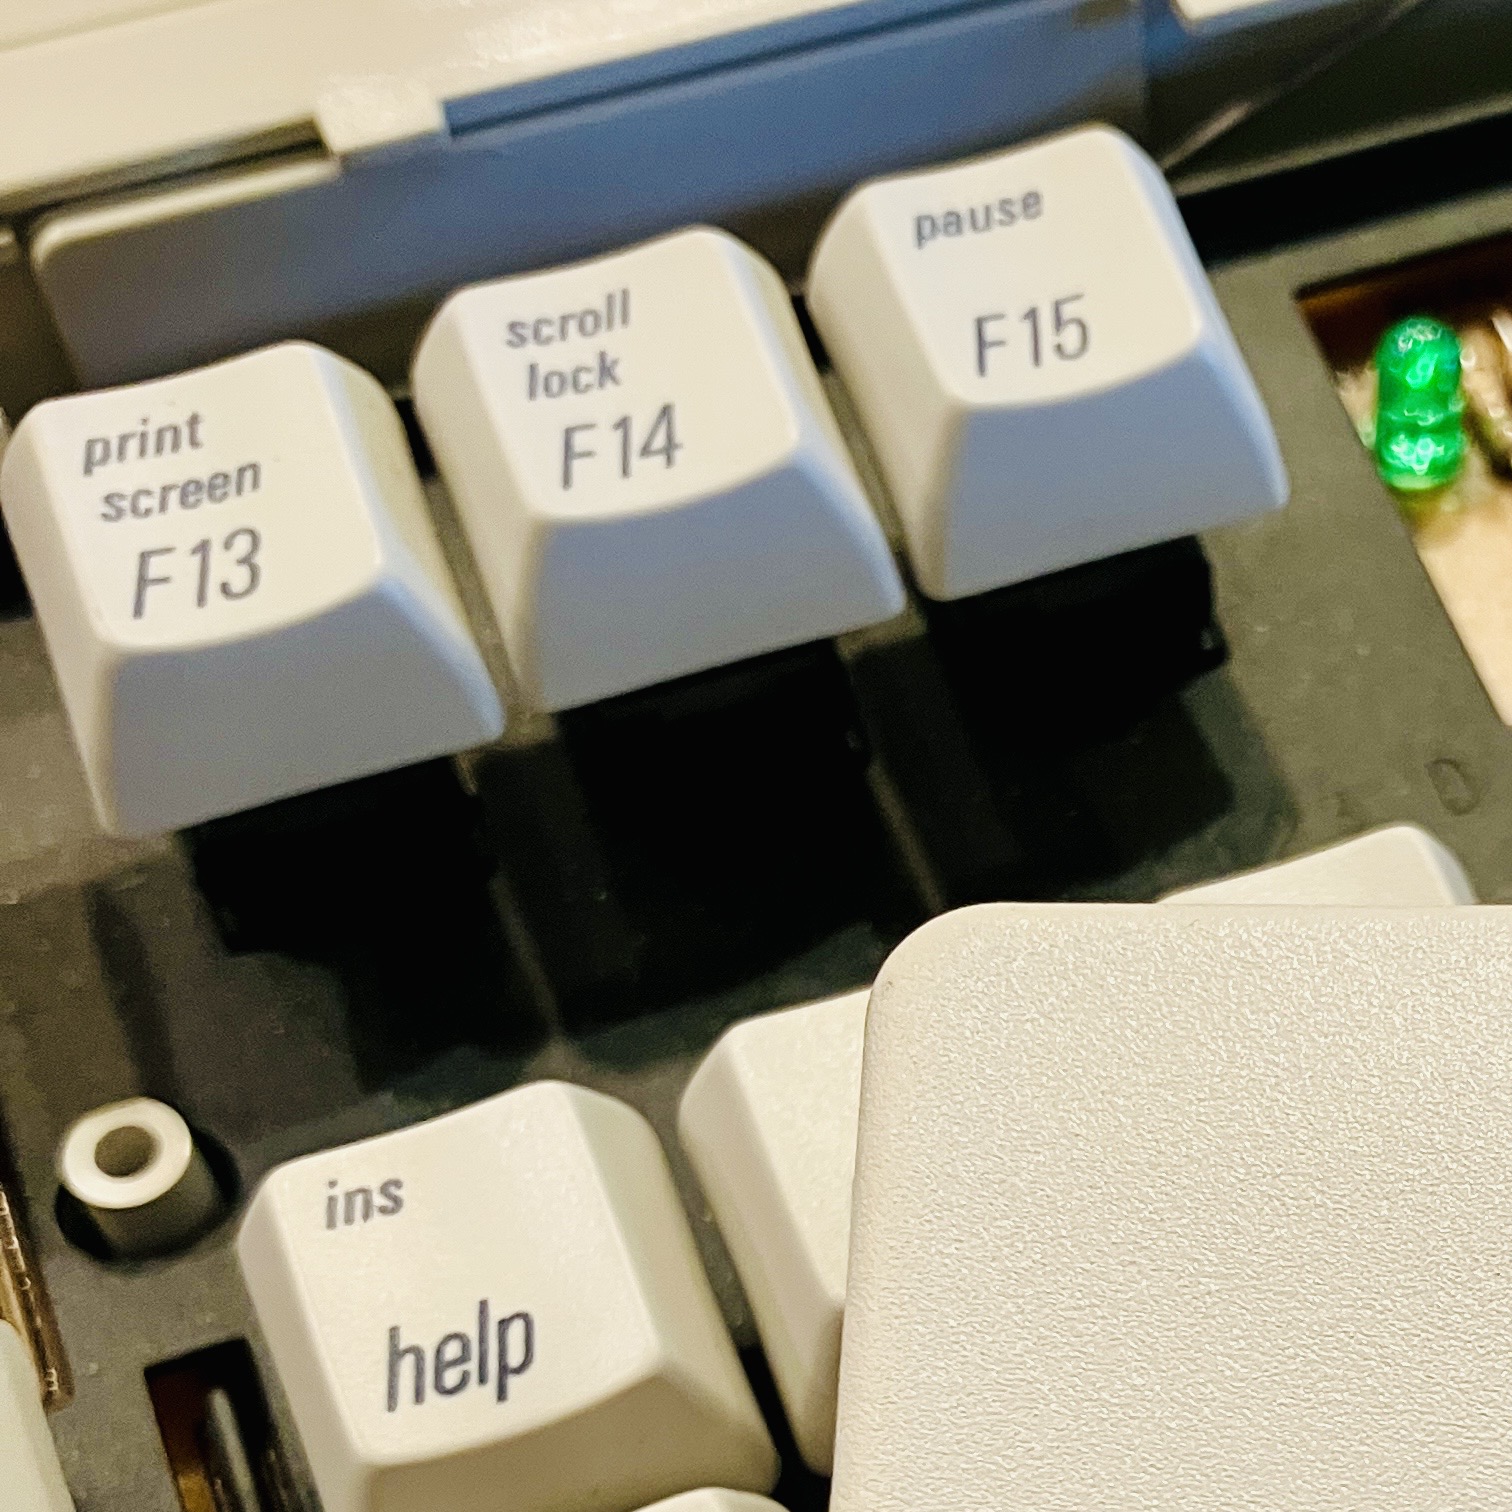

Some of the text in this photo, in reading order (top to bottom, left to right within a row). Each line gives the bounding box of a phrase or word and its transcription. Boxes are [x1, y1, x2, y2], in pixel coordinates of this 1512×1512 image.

[913, 188, 1044, 249] pause
[506, 288, 631, 348] scroll
[972, 292, 1089, 378] F15
[526, 351, 622, 400] lock
[82, 411, 205, 475] print
[561, 403, 684, 490] F14
[102, 461, 261, 521] screen
[132, 527, 264, 619] F13
[324, 1176, 404, 1230] ins
[387, 1299, 535, 1412] help
